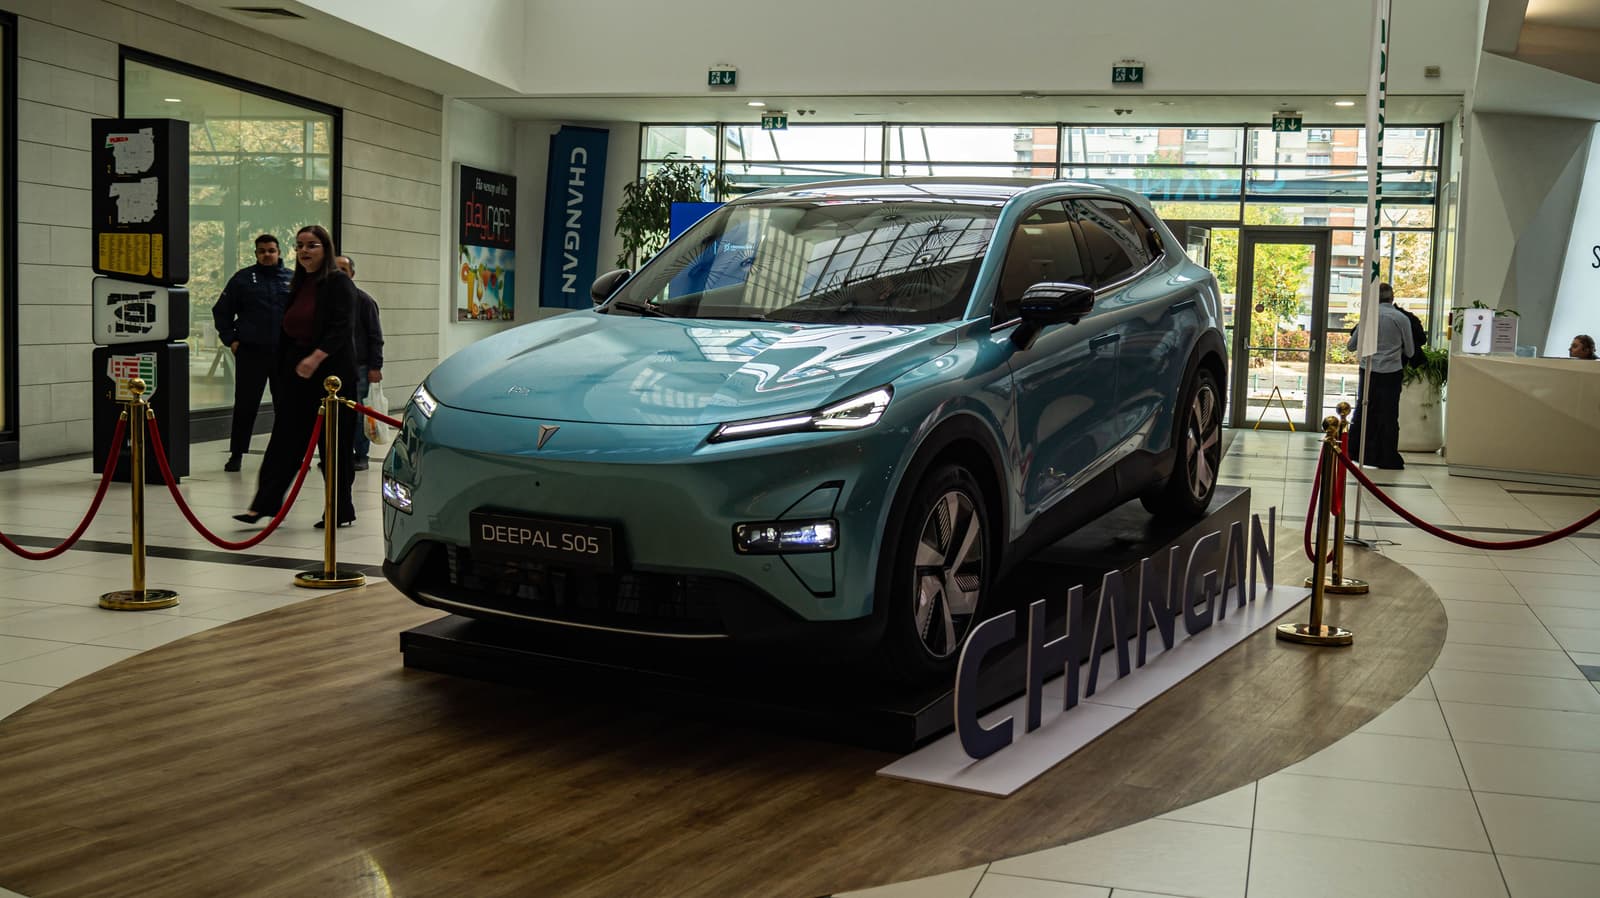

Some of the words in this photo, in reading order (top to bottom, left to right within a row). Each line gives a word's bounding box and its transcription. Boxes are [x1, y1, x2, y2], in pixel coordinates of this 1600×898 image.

[562, 147, 588, 294] CHANGAN
[1470, 314, 1484, 347] i
[481, 523, 558, 549] DEEPAL
[561, 533, 600, 554] S05
[954, 506, 1276, 760] CHANGAN
